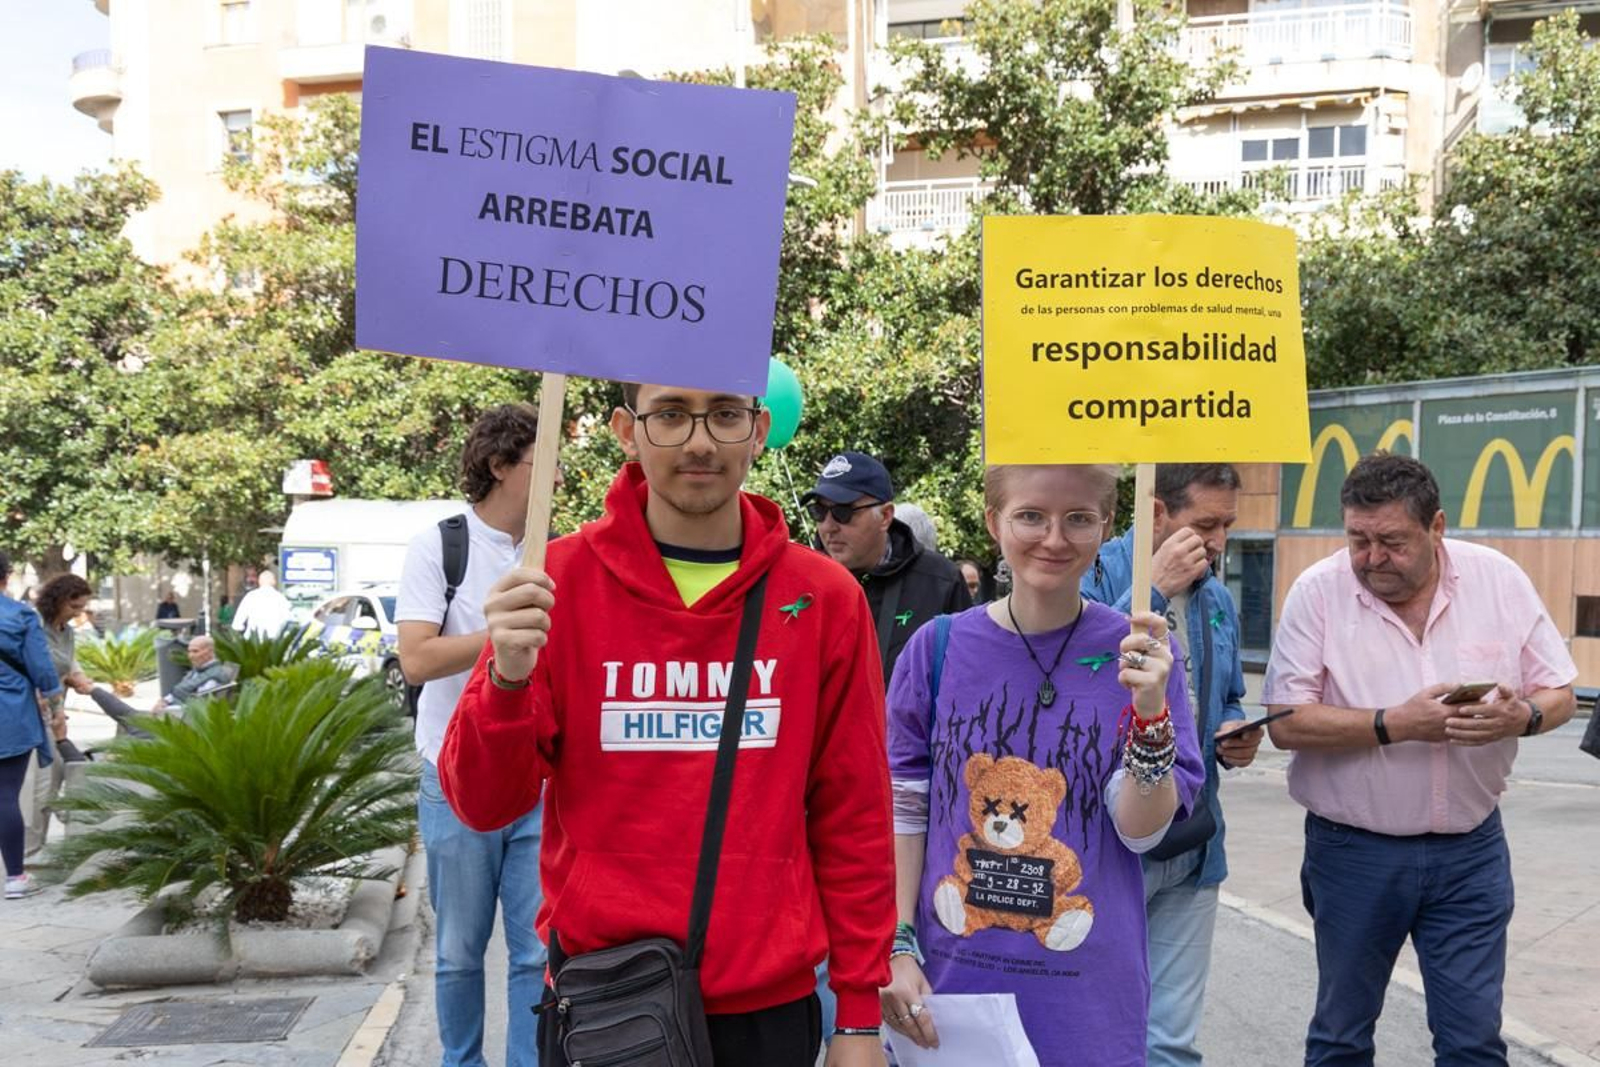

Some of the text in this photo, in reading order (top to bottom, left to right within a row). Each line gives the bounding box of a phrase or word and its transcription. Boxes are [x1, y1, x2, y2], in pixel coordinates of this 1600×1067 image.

[411, 122, 733, 185] EL ESTIGMA SOCIAL
[478, 192, 654, 239] ARREBATA
[437, 257, 706, 323] DERECHOS
[1015, 265, 1283, 294] Garantizar los derechos
[1020, 303, 1283, 319] de las personas con problemas de salud mental, una
[1031, 332, 1277, 370] responsabilidad
[1067, 390, 1251, 427] compartida
[1438, 414, 1462, 425] Plaza
[1463, 413, 1475, 423] de
[624, 711, 767, 739] HILFIGR
[975, 892, 985, 900] LA
[987, 894, 1015, 905] POLICE
